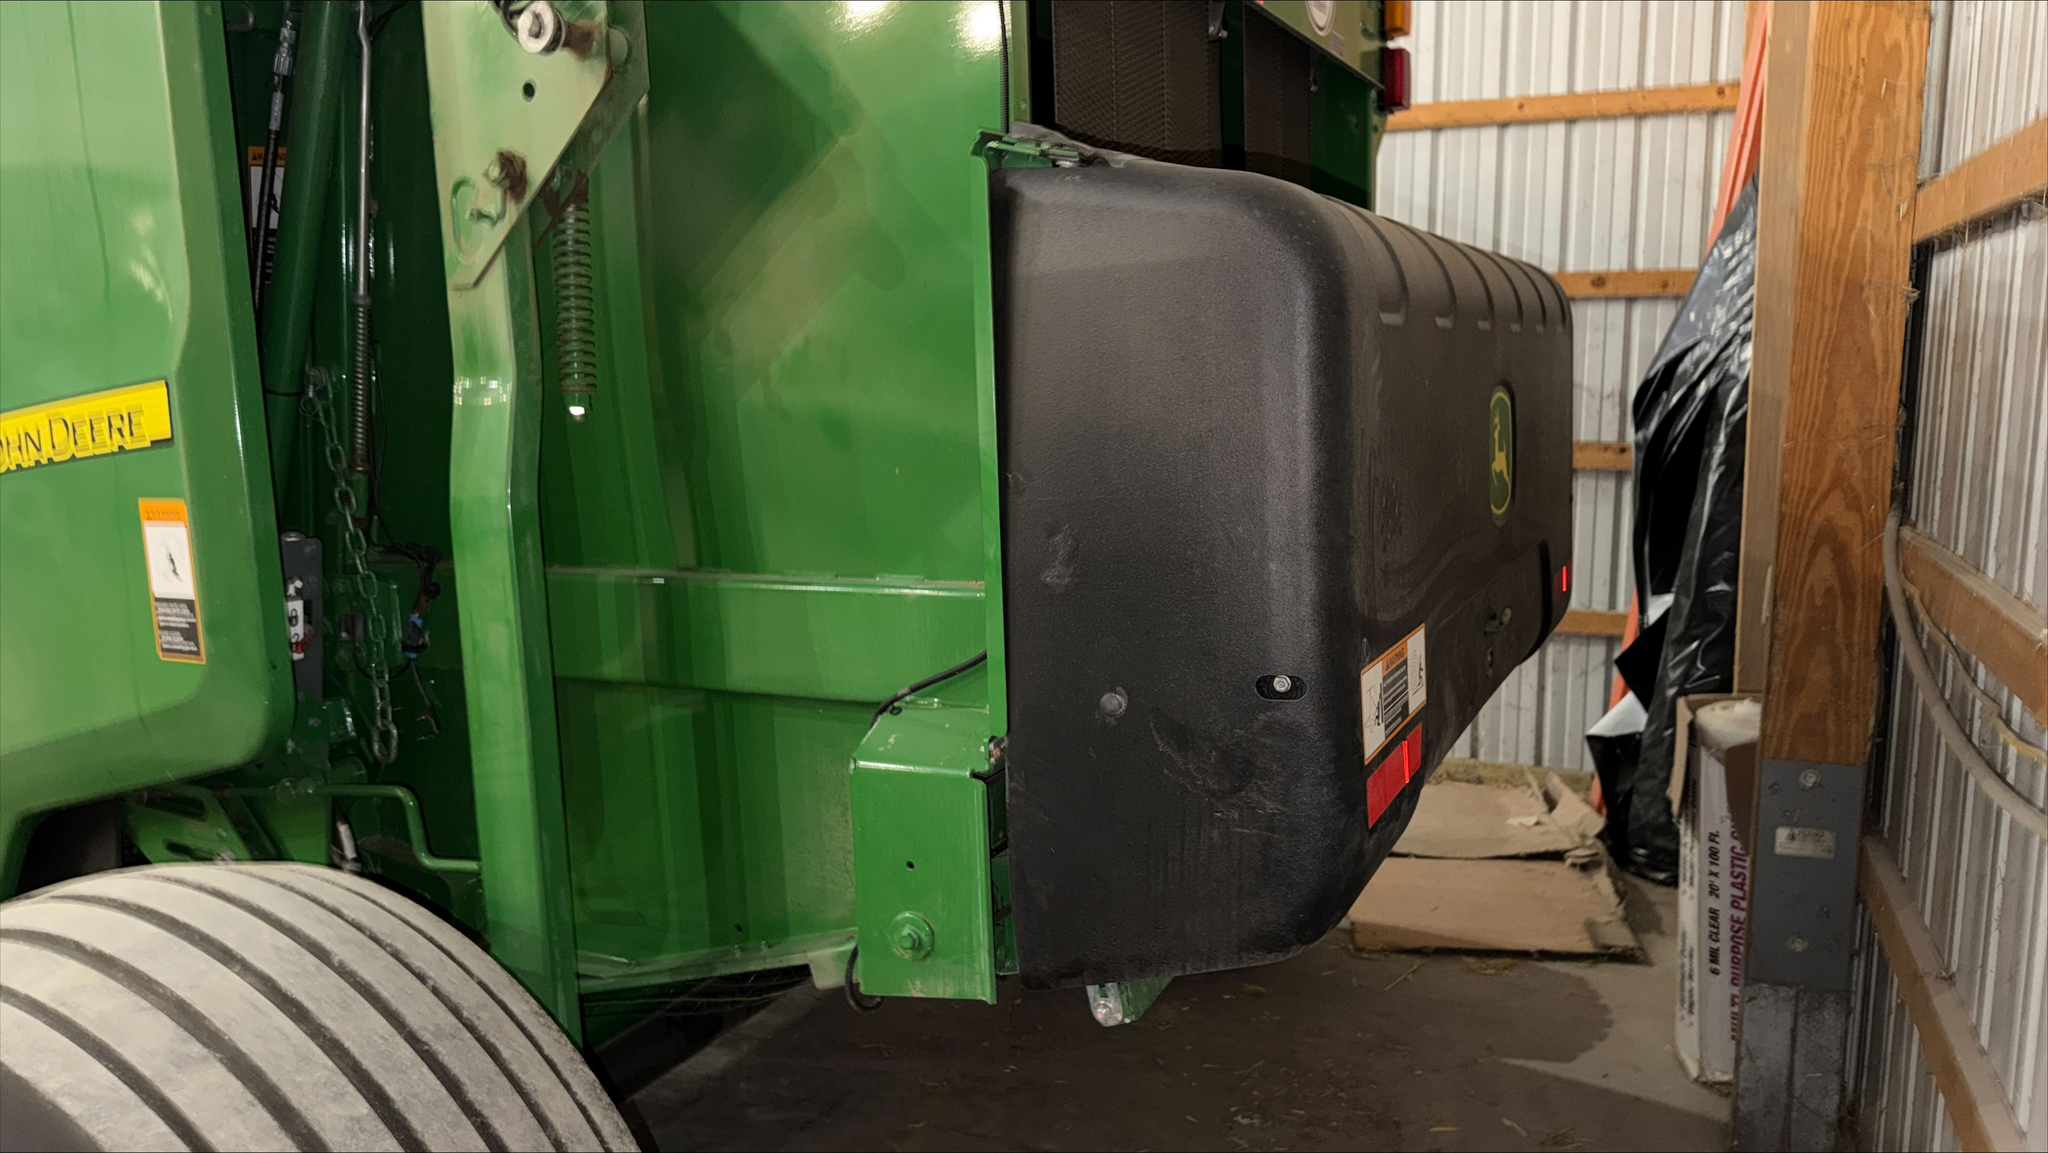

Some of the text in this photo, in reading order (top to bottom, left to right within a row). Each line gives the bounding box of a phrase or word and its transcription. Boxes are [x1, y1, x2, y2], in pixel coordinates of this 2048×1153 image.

[0, 405, 151, 473] HN DEERE
[1709, 846, 1719, 866] 100
[1709, 869, 1719, 879] X
[1729, 845, 1746, 912] PLASTIC
[1709, 880, 1720, 899] 20'
[1709, 907, 1720, 943] CLEAR
[1709, 946, 1720, 965] MIL
